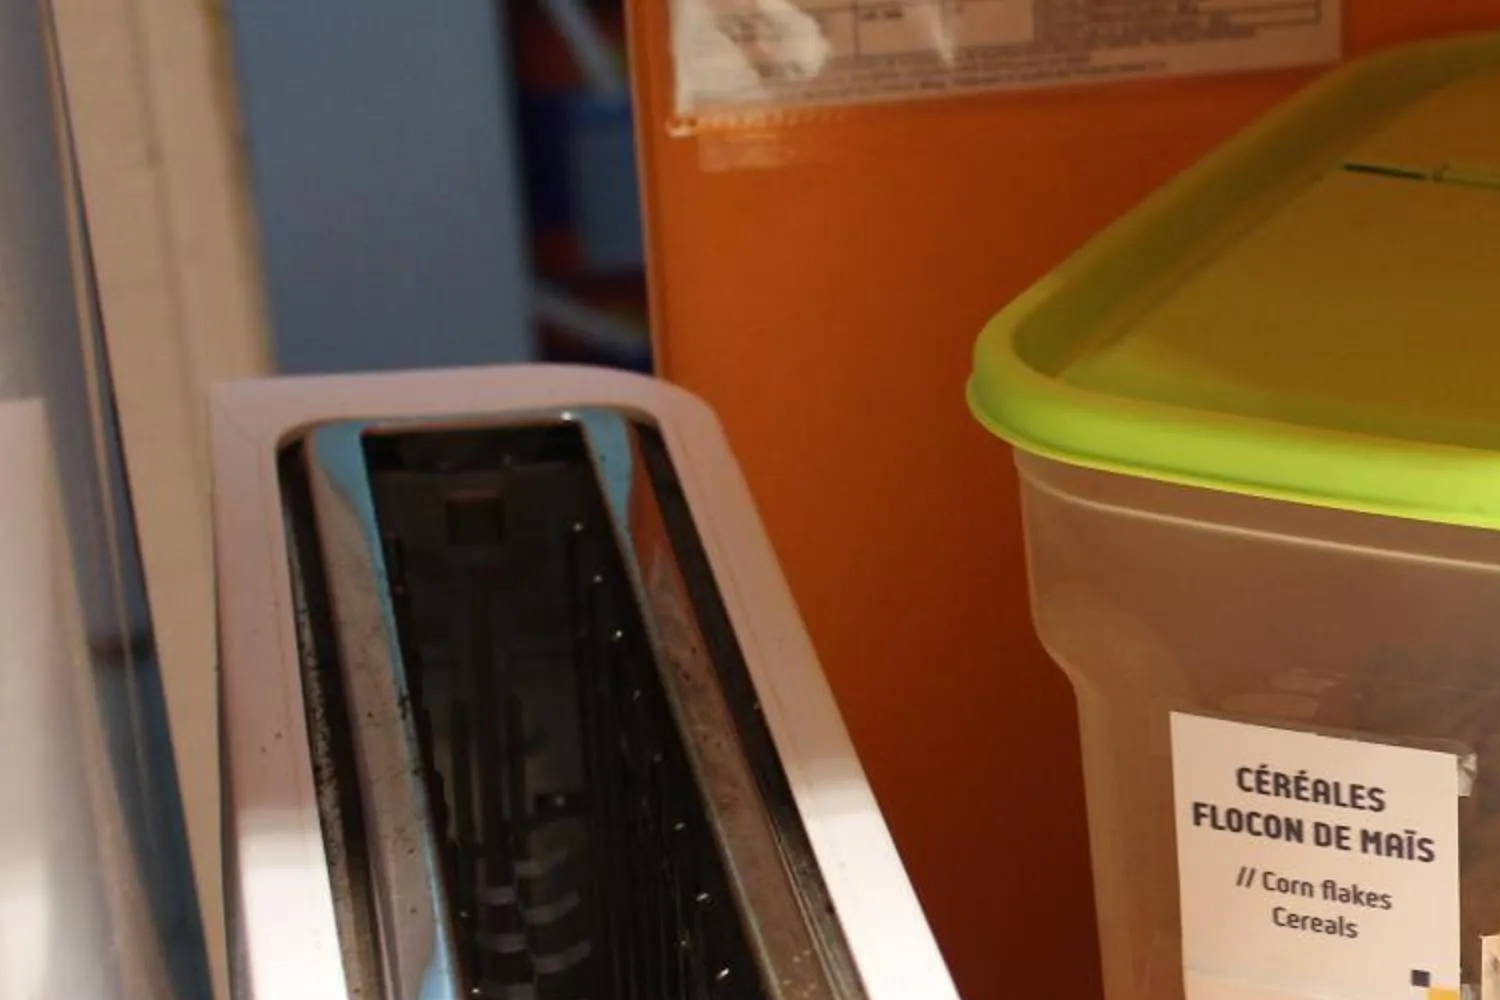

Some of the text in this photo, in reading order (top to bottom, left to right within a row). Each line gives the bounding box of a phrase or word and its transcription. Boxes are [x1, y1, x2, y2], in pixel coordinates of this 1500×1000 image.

[1236, 765, 1385, 812] CÉRÉALES
[1193, 802, 1435, 862] FLOCON DE MAÏS
[1263, 871, 1314, 898] Corn
[1322, 880, 1392, 910] flakes
[1272, 906, 1358, 938] Cereals
